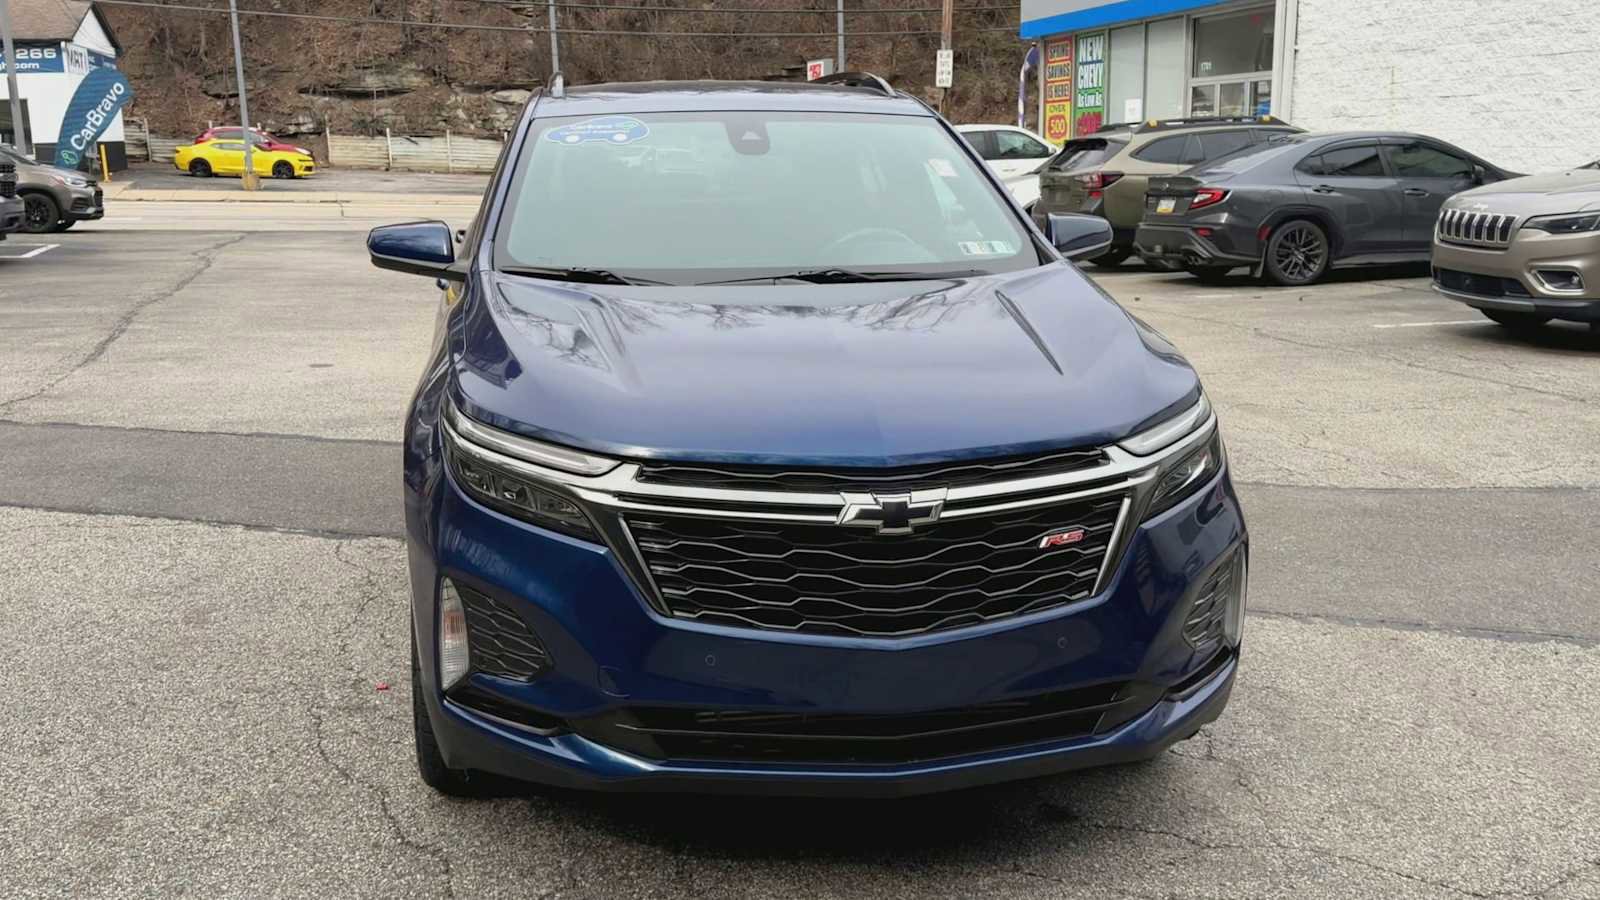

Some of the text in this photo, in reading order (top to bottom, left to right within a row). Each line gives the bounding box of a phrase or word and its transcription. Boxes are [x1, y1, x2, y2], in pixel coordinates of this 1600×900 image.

[1079, 36, 1104, 61] NEW
[1078, 63, 1104, 89] CHEVY
[70, 82, 125, 151] CarBravo
[1049, 104, 1066, 113] OVER
[1050, 119, 1065, 134] 500
[1039, 529, 1085, 549] RS
